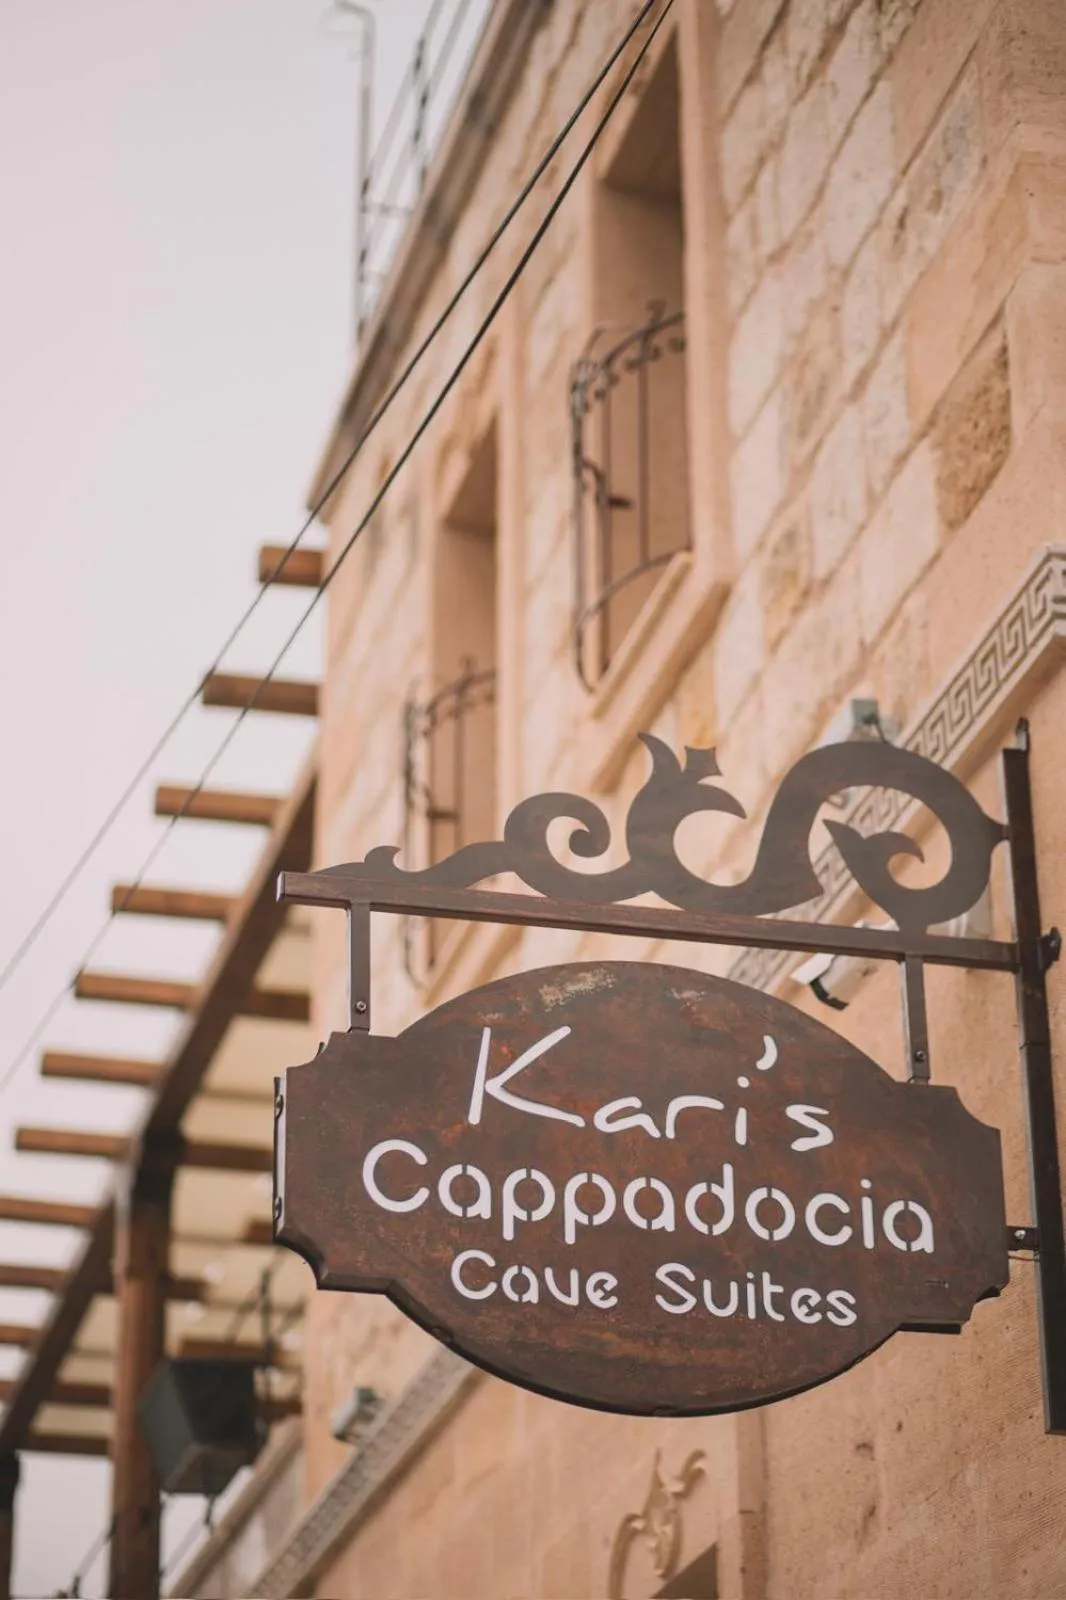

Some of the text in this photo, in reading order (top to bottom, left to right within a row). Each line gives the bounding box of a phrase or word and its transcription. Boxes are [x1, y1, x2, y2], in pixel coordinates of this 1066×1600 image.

[467, 1025, 834, 1152] Kari's
[362, 1139, 934, 1254] Cappadocia
[450, 1249, 857, 1326] Cave Suites
